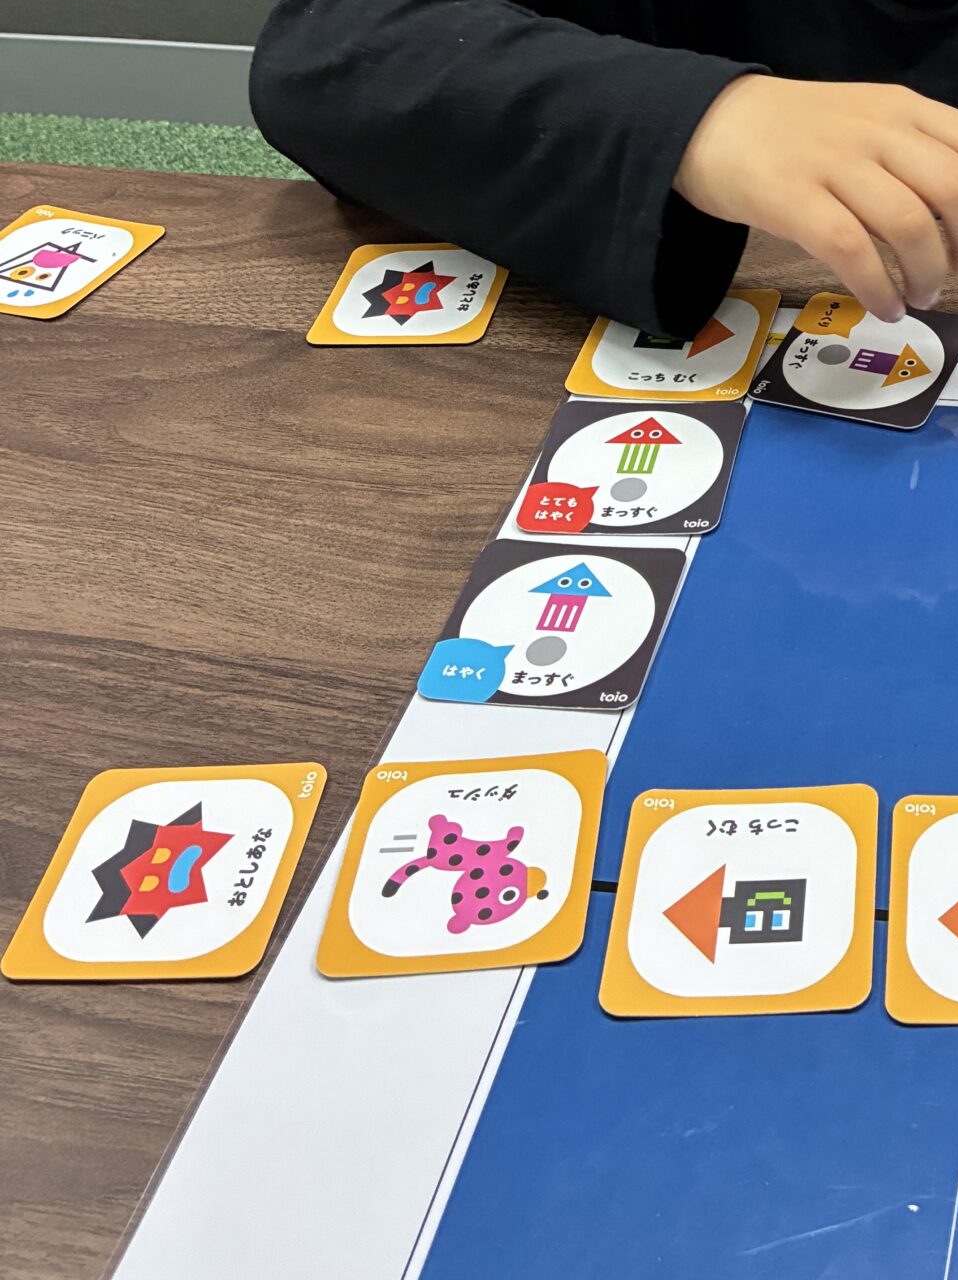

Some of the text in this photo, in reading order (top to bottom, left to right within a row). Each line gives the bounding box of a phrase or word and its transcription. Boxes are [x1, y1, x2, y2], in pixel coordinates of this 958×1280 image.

[457, 273, 483, 312] おとしあな
[818, 302, 840, 328] ゆっくり
[788, 338, 818, 369] まっすぐ
[628, 372, 698, 384] こっち むく
[715, 387, 739, 396] toio
[754, 380, 771, 394] toio
[540, 496, 578, 507] とても
[534, 510, 574, 522] はやく
[601, 506, 658, 518] まっすぐ
[683, 519, 710, 528] toio
[442, 664, 486, 680] はやく
[511, 670, 575, 687] まっすぐ
[600, 691, 628, 703] toio
[376, 770, 408, 782] toio
[297, 771, 318, 798] toio
[448, 783, 518, 801] ダッシュ
[643, 798, 675, 810] toio
[904, 803, 936, 816] toio
[706, 819, 800, 836] こっち むく
[227, 828, 272, 907] おとしあな
